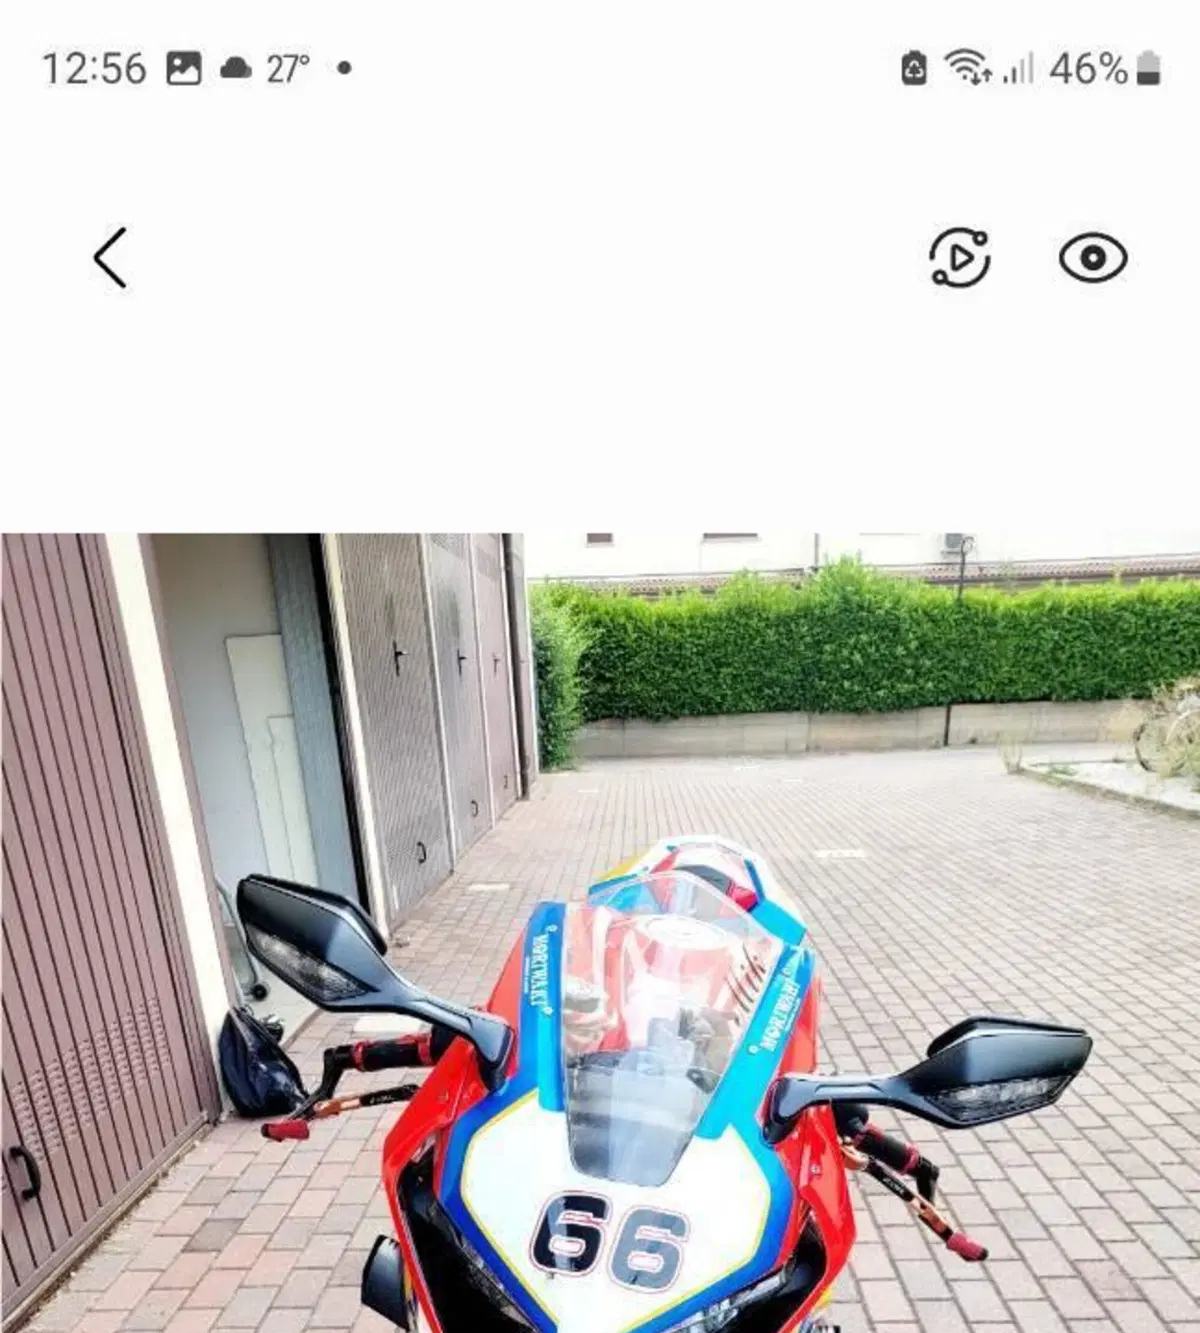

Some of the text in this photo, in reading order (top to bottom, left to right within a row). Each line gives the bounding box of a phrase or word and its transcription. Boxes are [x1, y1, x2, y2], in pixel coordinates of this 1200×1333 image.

[43, 51, 310, 84] 12:56 27°
[1049, 51, 1128, 84] 46%
[529, 1190, 691, 1294] 66
